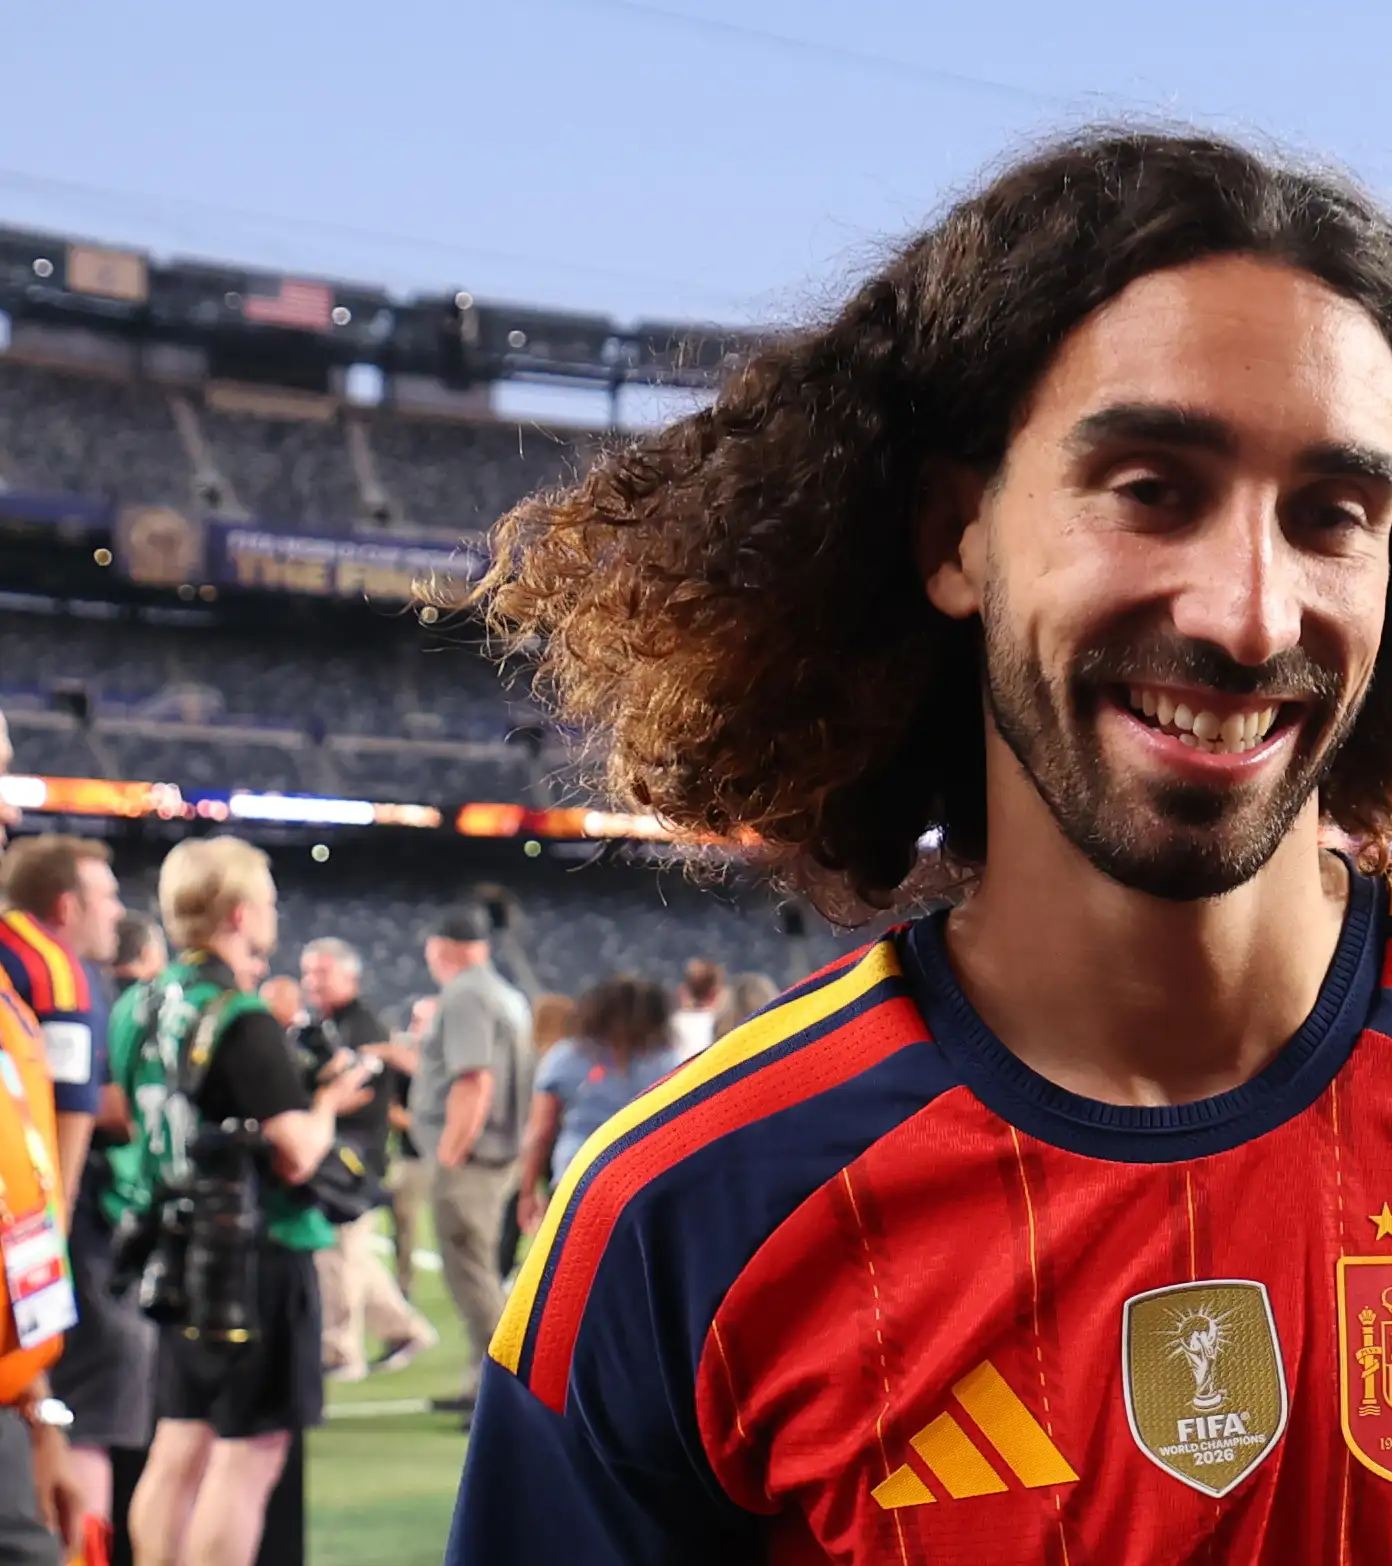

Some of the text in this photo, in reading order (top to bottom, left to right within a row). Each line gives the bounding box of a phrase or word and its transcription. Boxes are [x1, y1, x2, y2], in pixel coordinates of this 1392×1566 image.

[1177, 1412, 1247, 1443] FIFA
[1159, 1433, 1267, 1457] WORLD CHAMPIONS
[1380, 1437, 1392, 1451] 19
[1193, 1448, 1235, 1466] 2026
